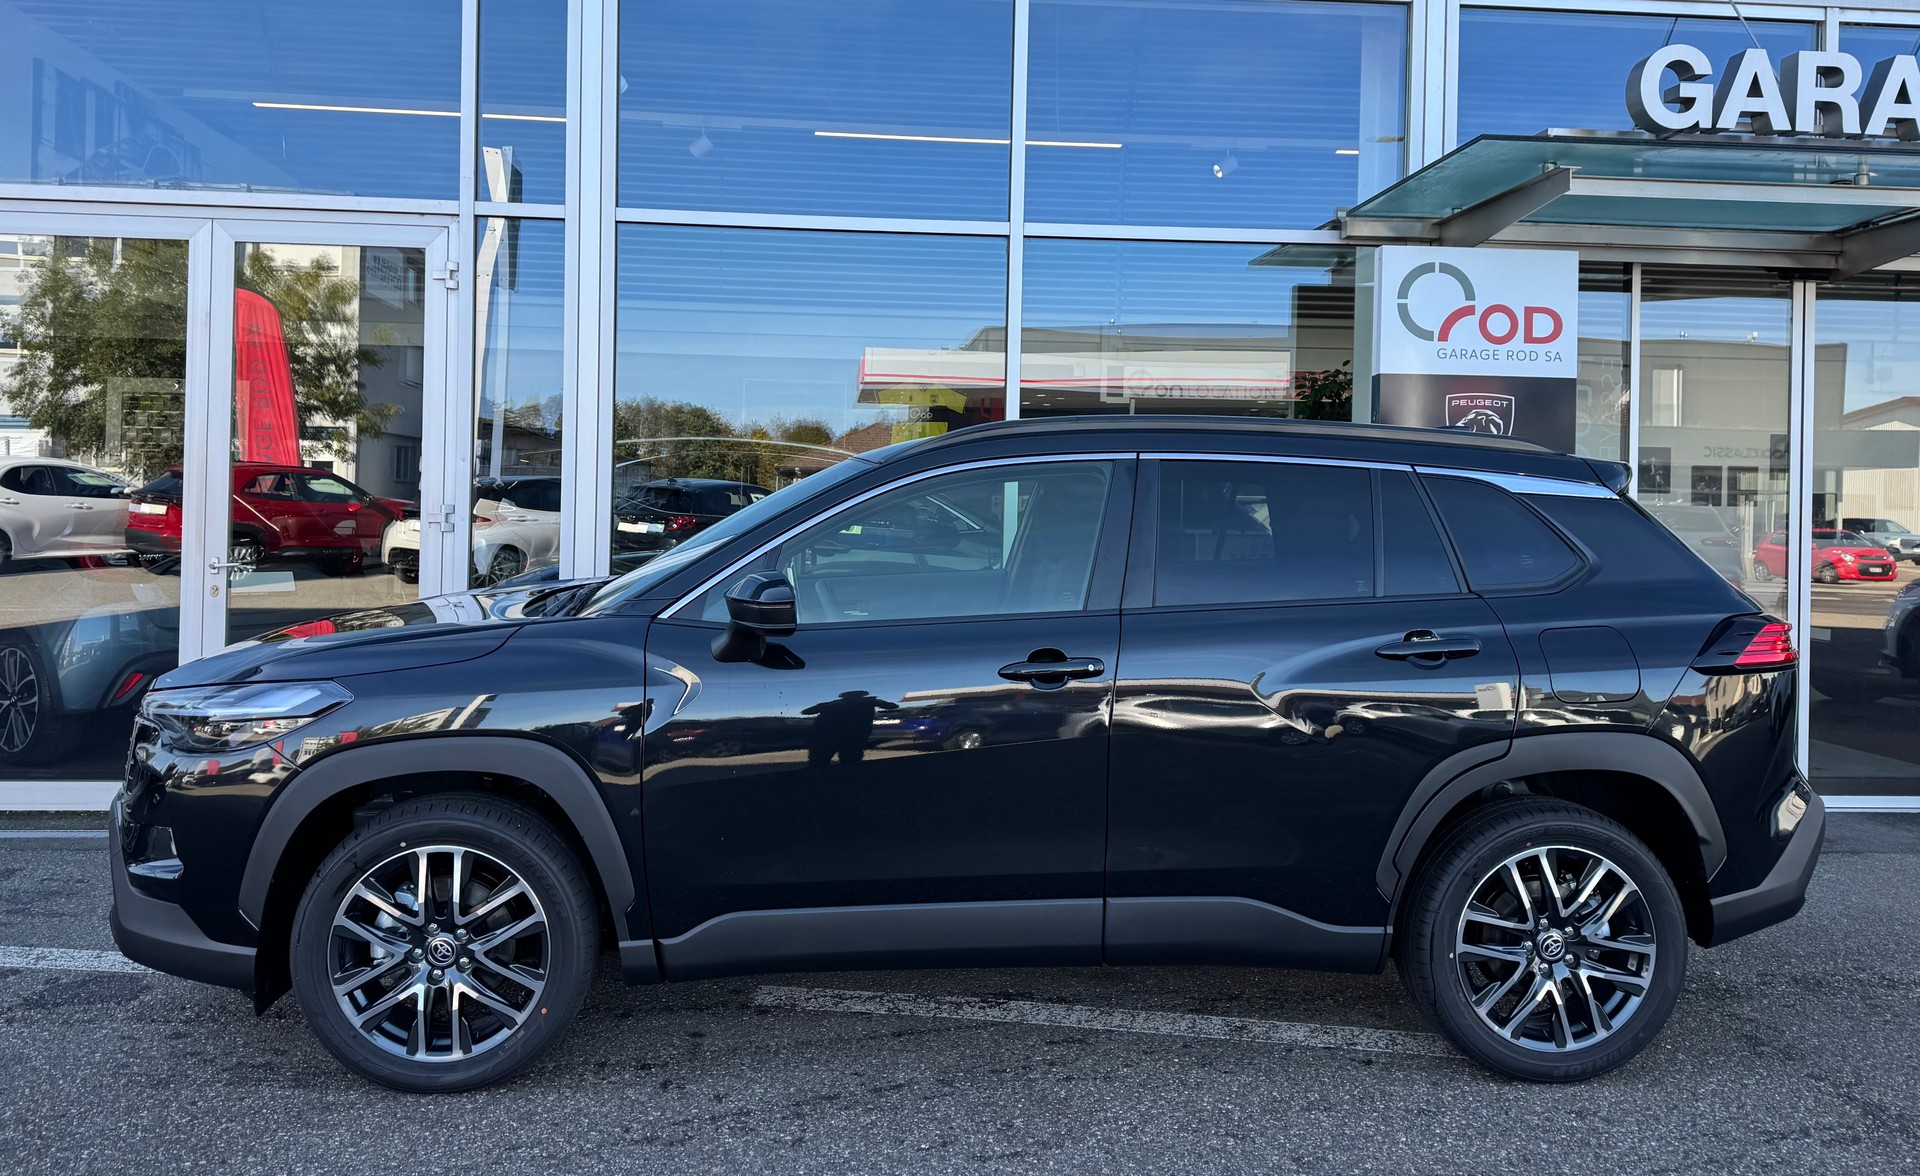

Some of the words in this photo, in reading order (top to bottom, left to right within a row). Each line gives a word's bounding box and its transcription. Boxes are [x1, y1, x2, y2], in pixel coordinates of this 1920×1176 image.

[1627, 43, 1920, 140] GARA
[1436, 347, 1500, 361] GARAGE
[1506, 349, 1539, 362] ROD
[1544, 350, 1563, 363] SA
[1451, 399, 1509, 407] PEUGEOT
